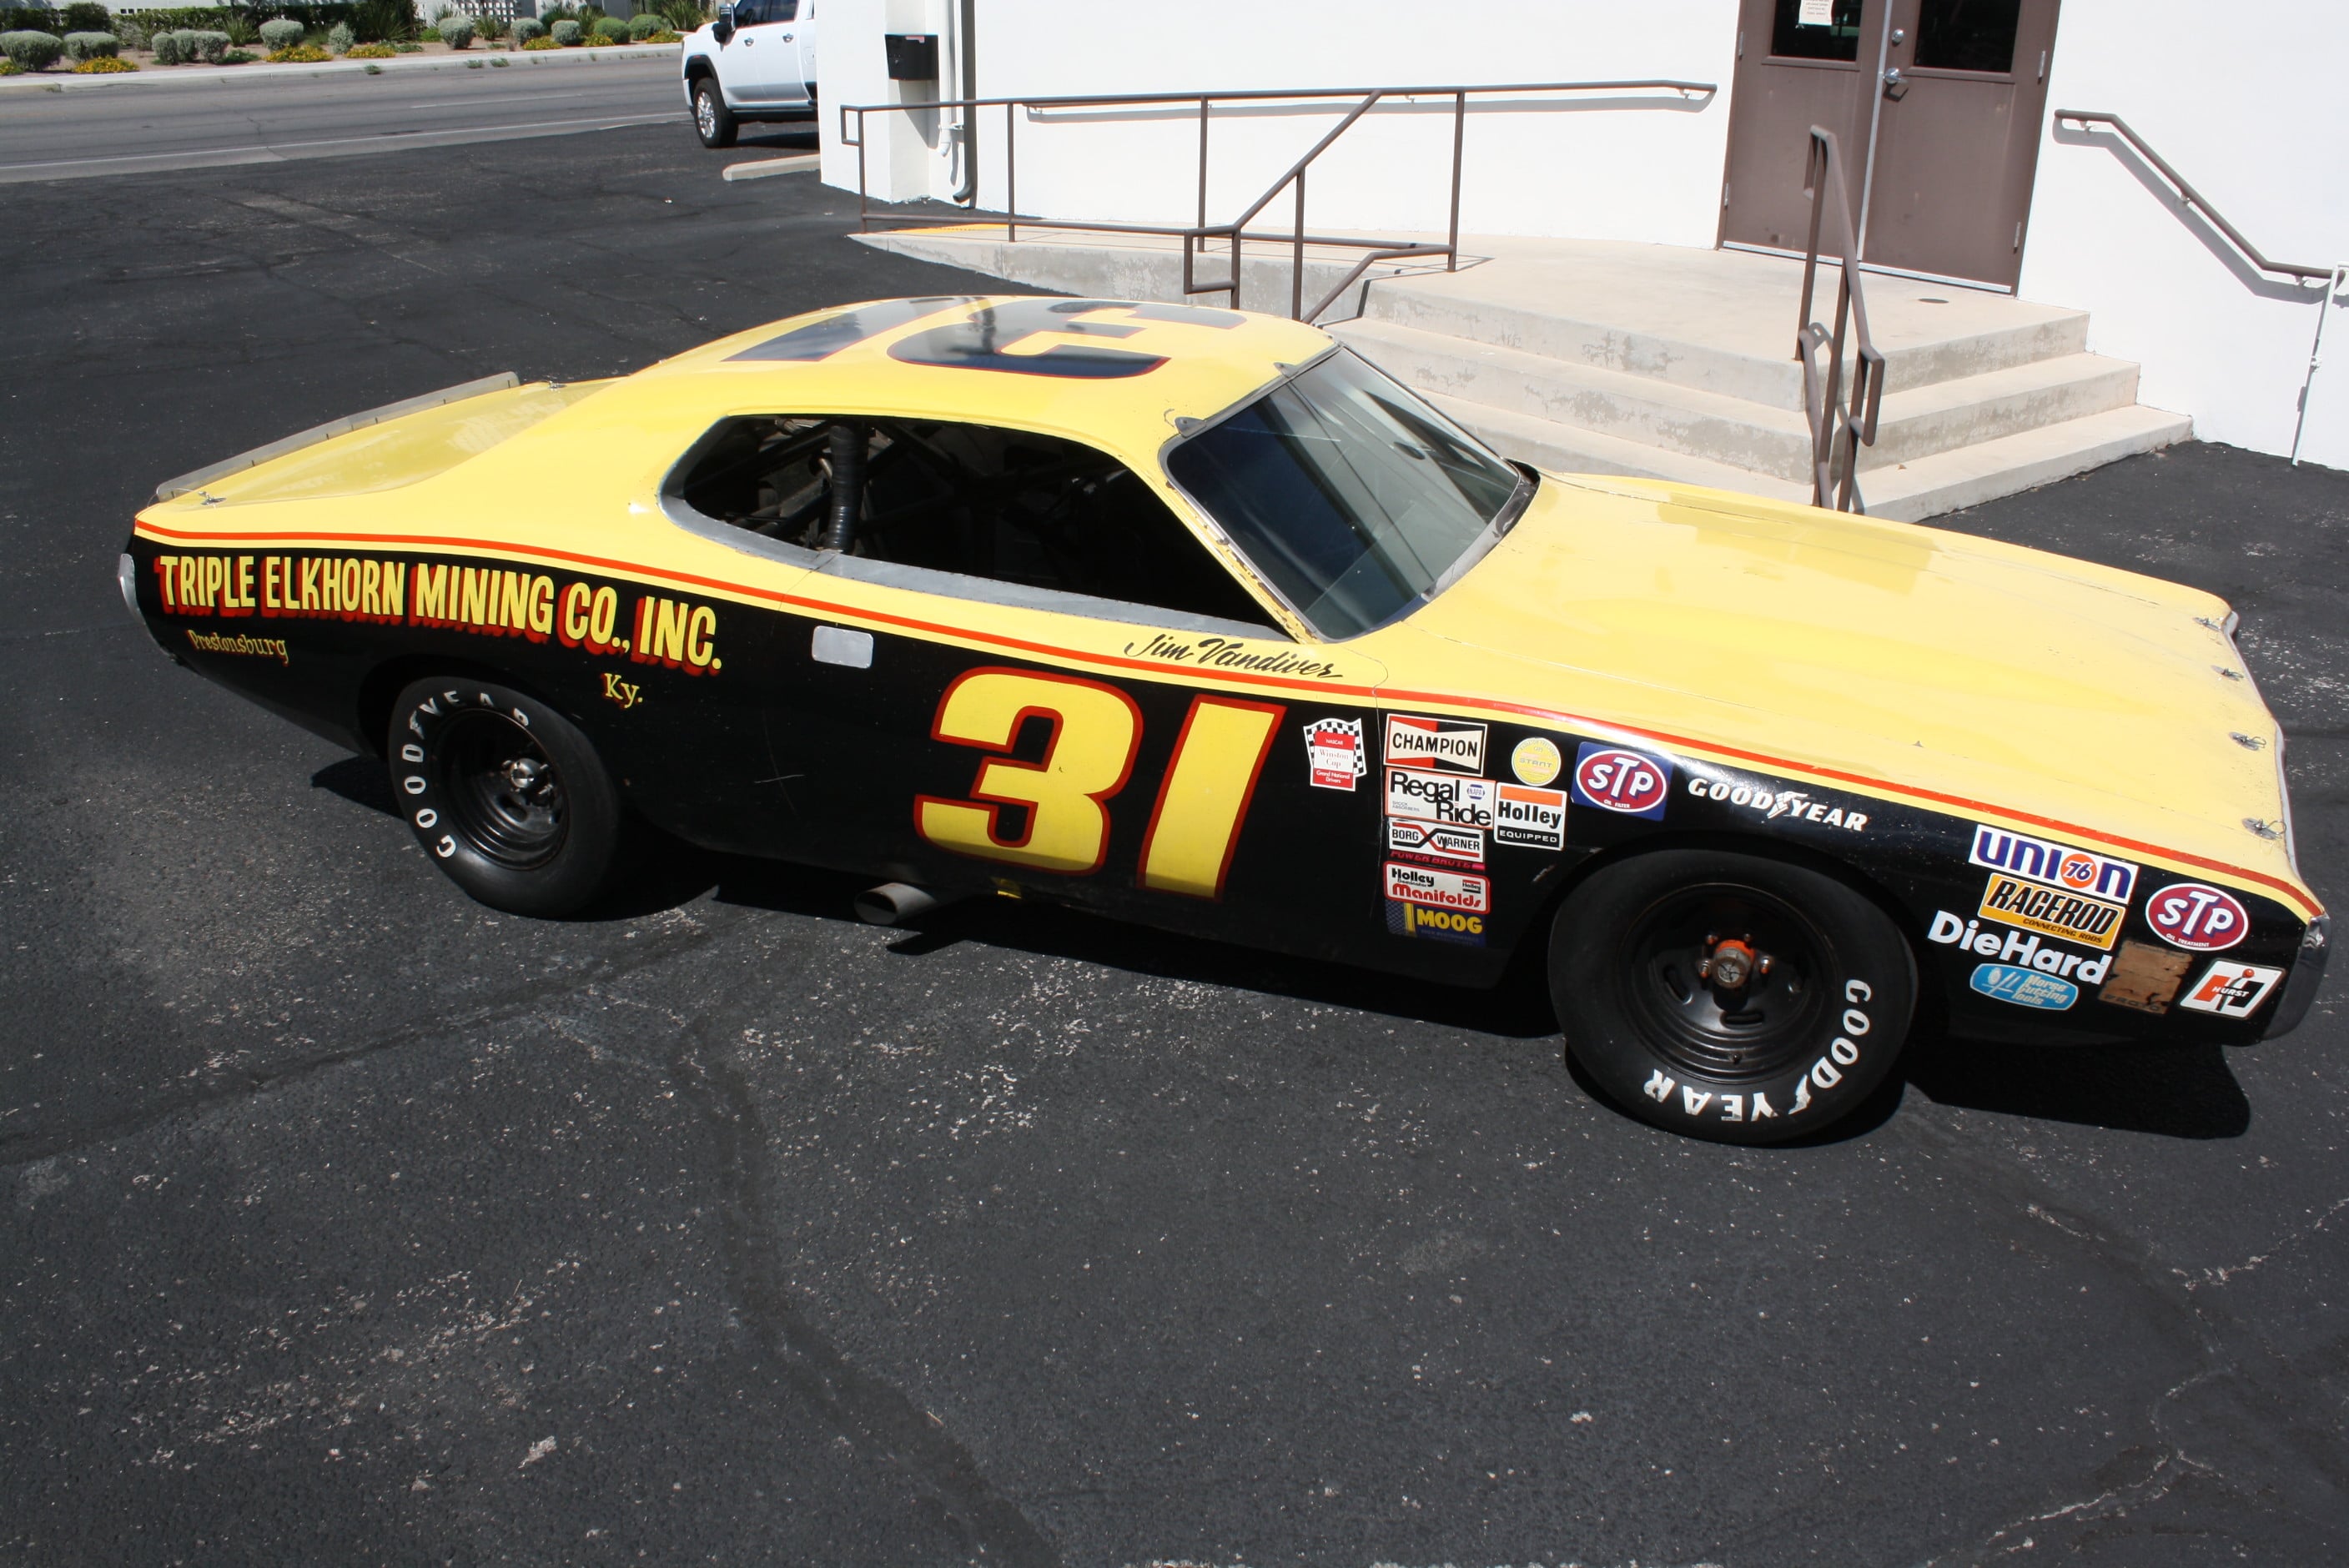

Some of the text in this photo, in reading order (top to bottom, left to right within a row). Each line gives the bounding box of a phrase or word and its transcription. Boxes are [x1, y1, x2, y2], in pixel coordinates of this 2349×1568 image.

[156, 555, 722, 673] TRIPLE ELKHORN MINING CO., INC.
[186, 629, 289, 666] Prestonsburg
[1124, 633, 1343, 679] Jim Vandiver
[602, 672, 643, 709] Ky.
[1319, 748, 1349, 761] Winston
[1392, 732, 1478, 757] CHAMPION
[1326, 758, 1341, 769] Cup
[1331, 771, 1351, 780] National
[913, 666, 1288, 902] 31
[1390, 771, 1461, 804] Regal
[1587, 756, 1656, 798] STP
[1468, 787, 1483, 796] NAPA
[1687, 777, 1869, 832] GOODYEAR
[1436, 801, 1491, 827] Ride
[1497, 801, 1562, 829] Holley
[1392, 829, 1481, 851] BORG WARNER
[1499, 830, 1557, 843] EQUIPPED
[1391, 867, 1435, 887] Holley
[2063, 861, 2091, 882] 76
[1392, 882, 1481, 907] Manifolds
[1986, 879, 2119, 935] RACEROD
[1416, 908, 1483, 934] MOOG
[2157, 890, 2234, 935] STP
[2022, 917, 2103, 944] CONNECTING RODS
[2165, 932, 2210, 947] OIL TREATMENT
[1927, 909, 2113, 985] DieHard
[2026, 973, 2070, 992] Morse
[2211, 985, 2250, 998] HURST
